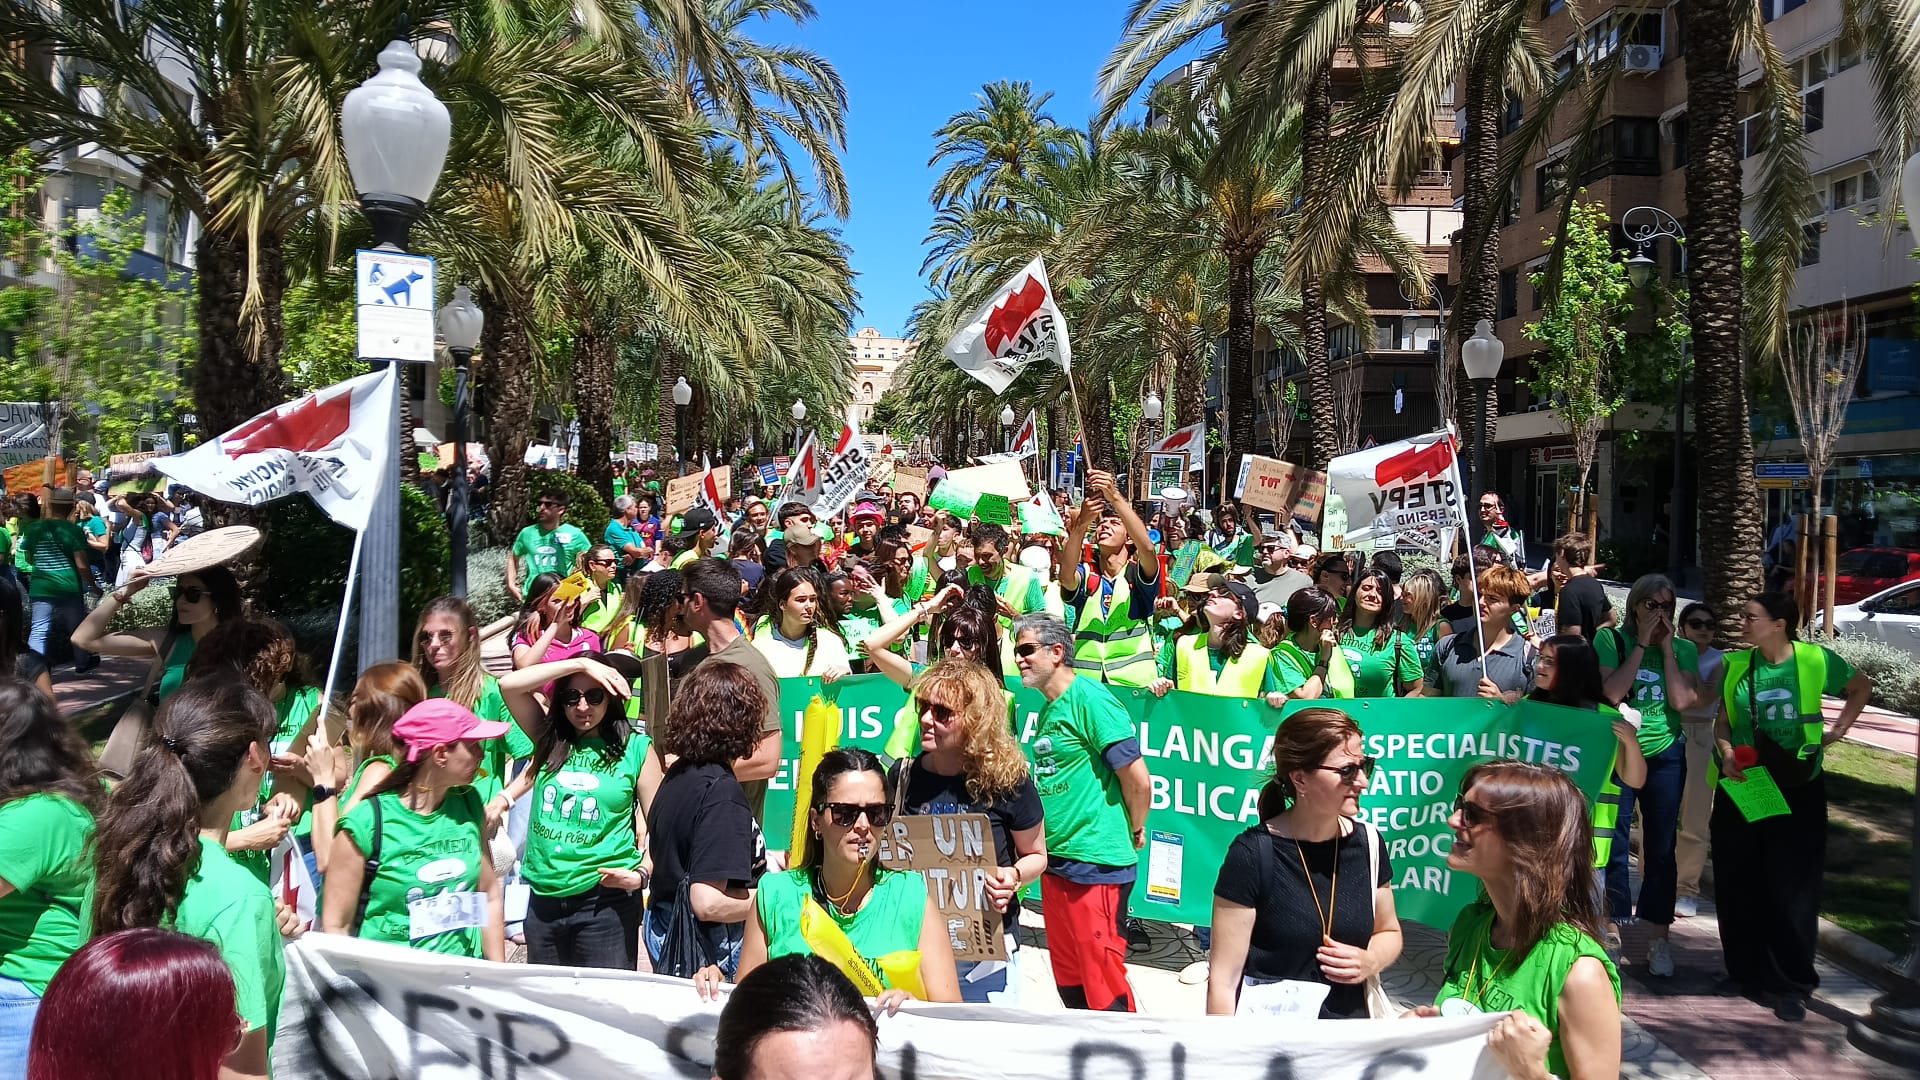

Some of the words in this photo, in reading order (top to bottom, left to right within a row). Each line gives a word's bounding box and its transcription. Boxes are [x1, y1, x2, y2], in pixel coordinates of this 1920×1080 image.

[1259, 475, 1281, 489] TOT
[1130, 721, 1277, 771] LANGA
[1149, 774, 1261, 823] BLICA
[565, 829, 598, 846] PÚBLI
[932, 815, 984, 857] UN
[1384, 833, 1458, 861] ROC
[921, 867, 991, 912] TUR
